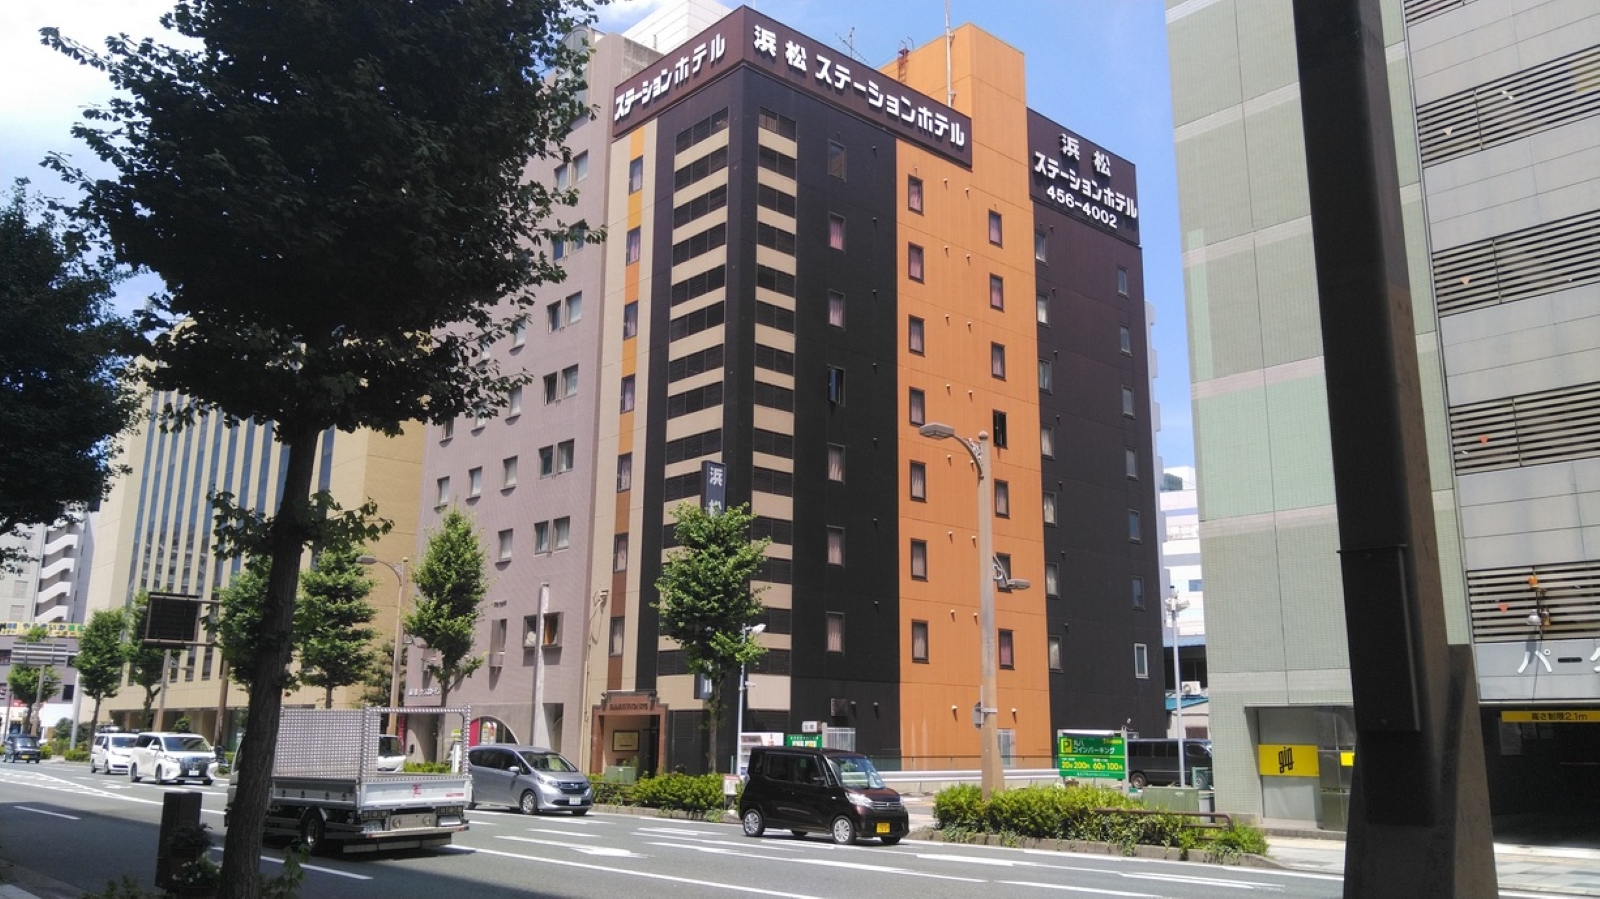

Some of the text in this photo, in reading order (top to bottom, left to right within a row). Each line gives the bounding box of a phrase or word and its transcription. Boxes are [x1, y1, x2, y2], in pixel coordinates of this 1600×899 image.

[614, 34, 725, 121] ステーションホテル
[1035, 151, 1137, 218] ステーションホテル
[1046, 185, 1117, 228] 456-4002
[1073, 747, 1115, 755] コインパーキング
